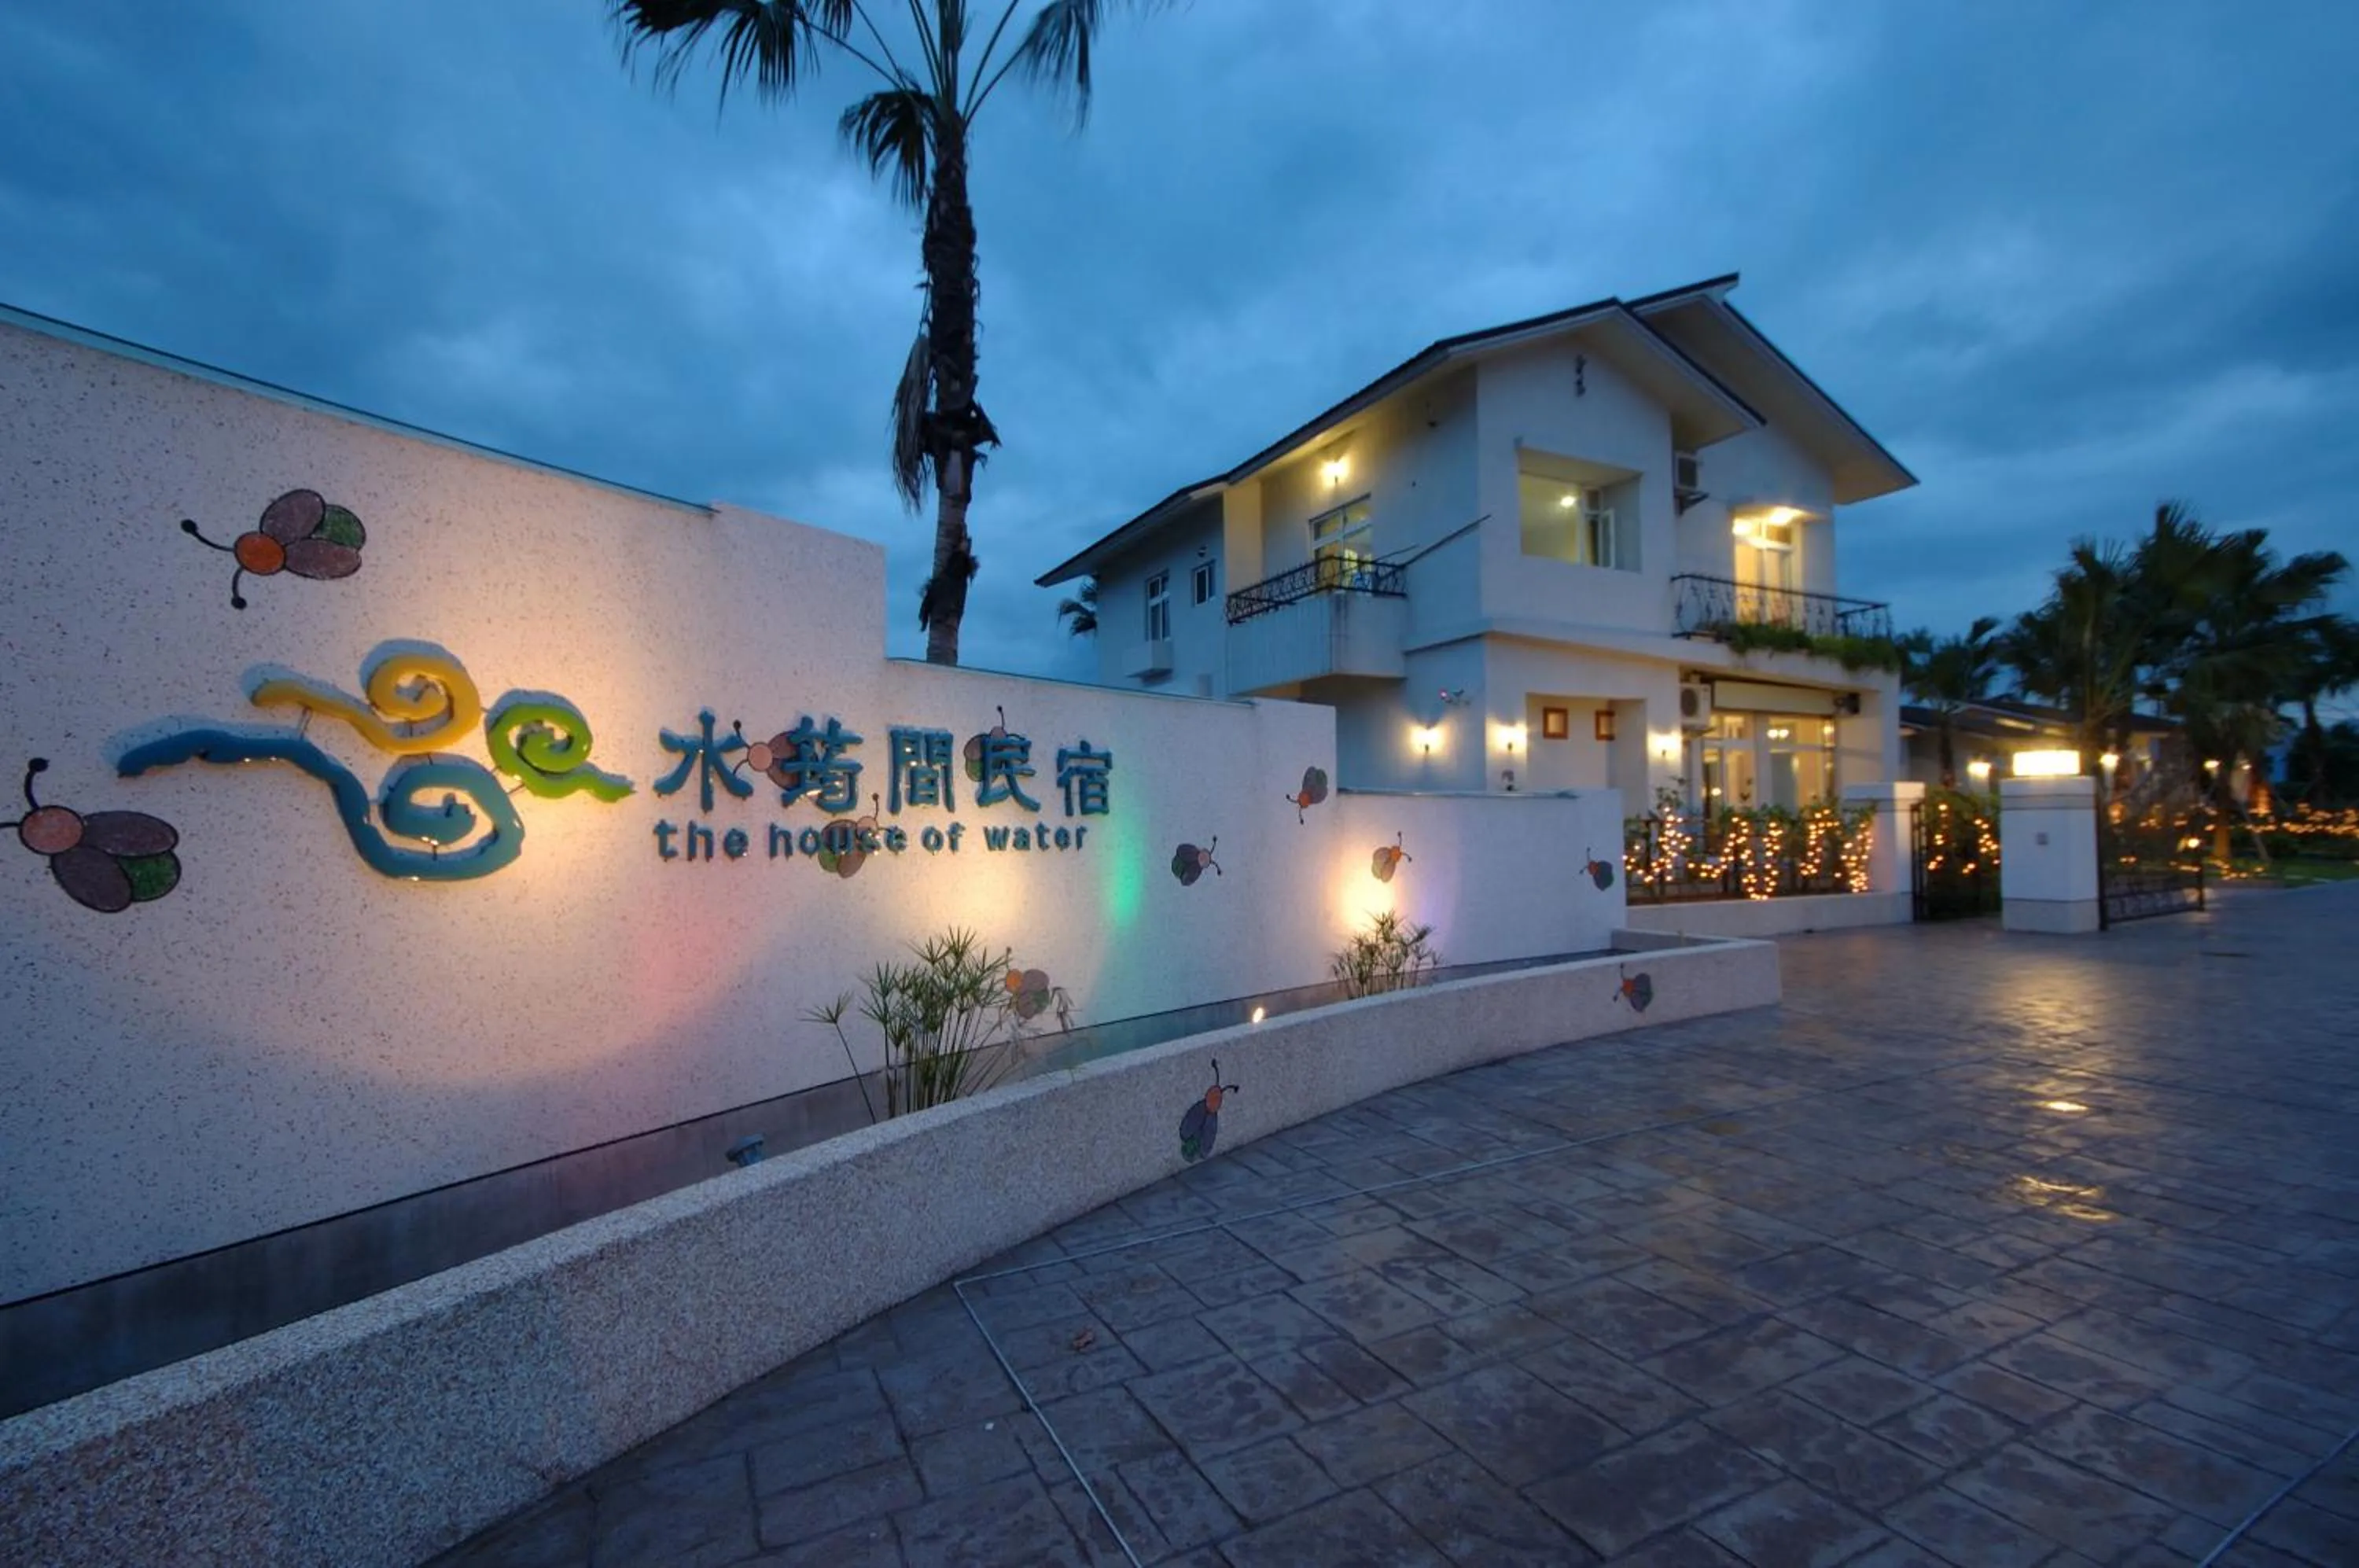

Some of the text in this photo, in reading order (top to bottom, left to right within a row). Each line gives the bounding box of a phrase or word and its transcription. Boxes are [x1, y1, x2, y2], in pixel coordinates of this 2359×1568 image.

[653, 819, 1087, 860] the house of water
